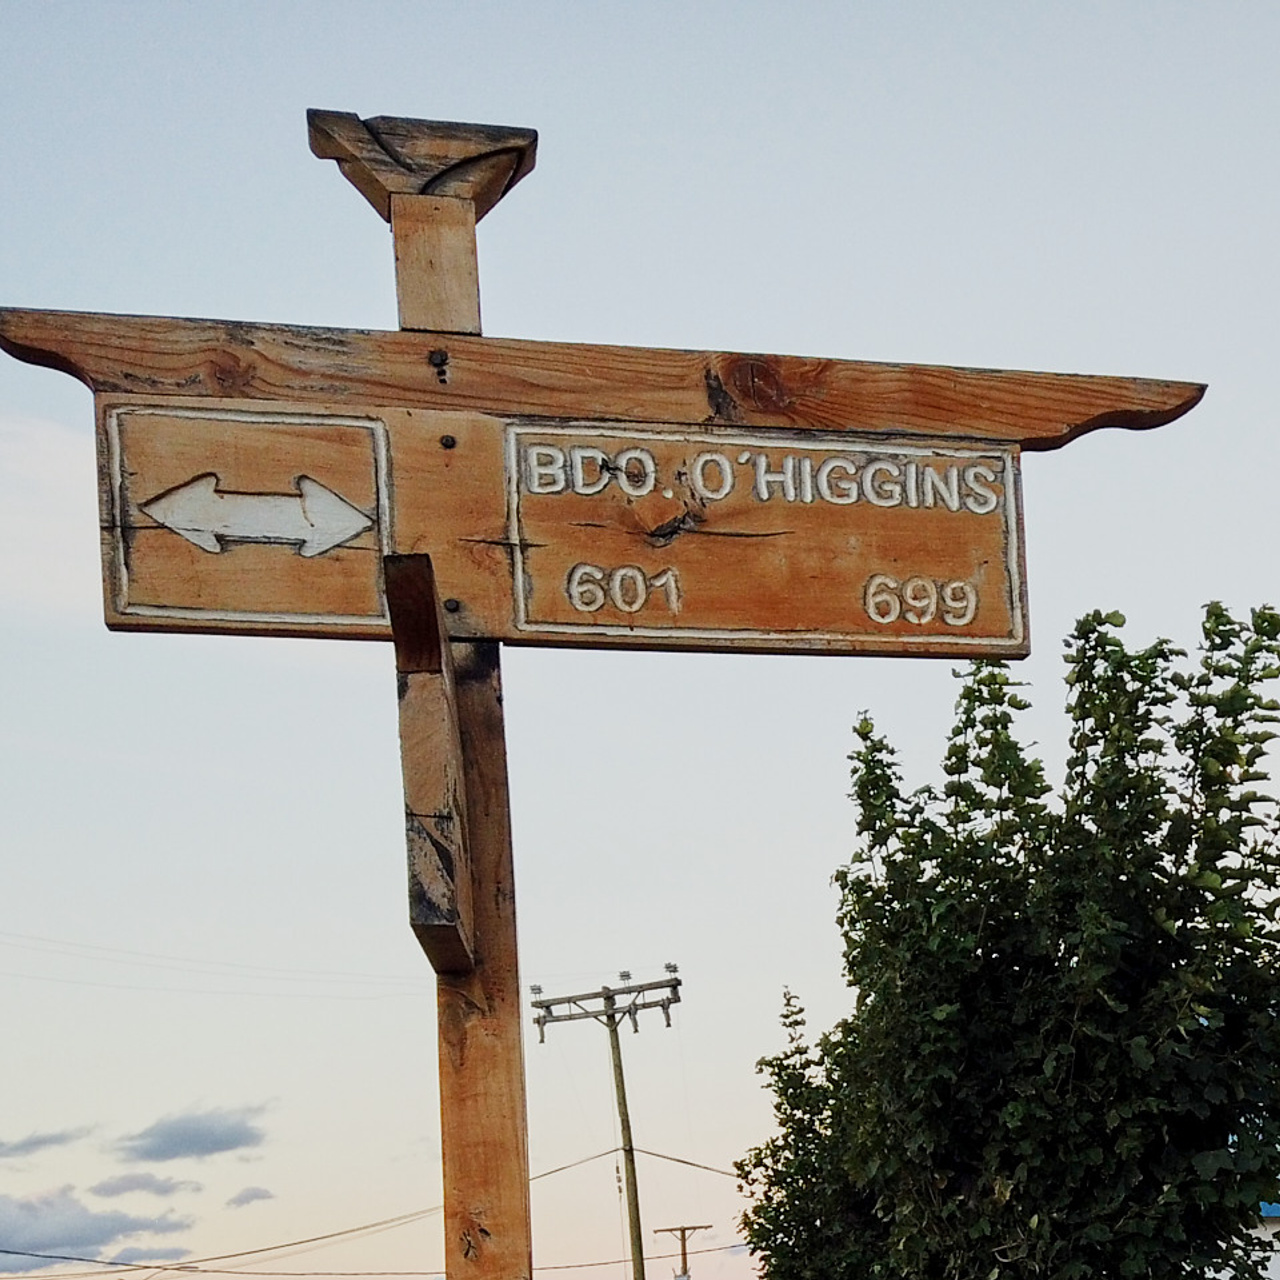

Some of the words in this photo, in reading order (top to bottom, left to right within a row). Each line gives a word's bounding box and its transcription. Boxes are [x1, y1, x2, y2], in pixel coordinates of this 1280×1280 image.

[526, 444, 674, 500] BDO.
[568, 564, 680, 614] 601
[864, 574, 977, 624] 699
